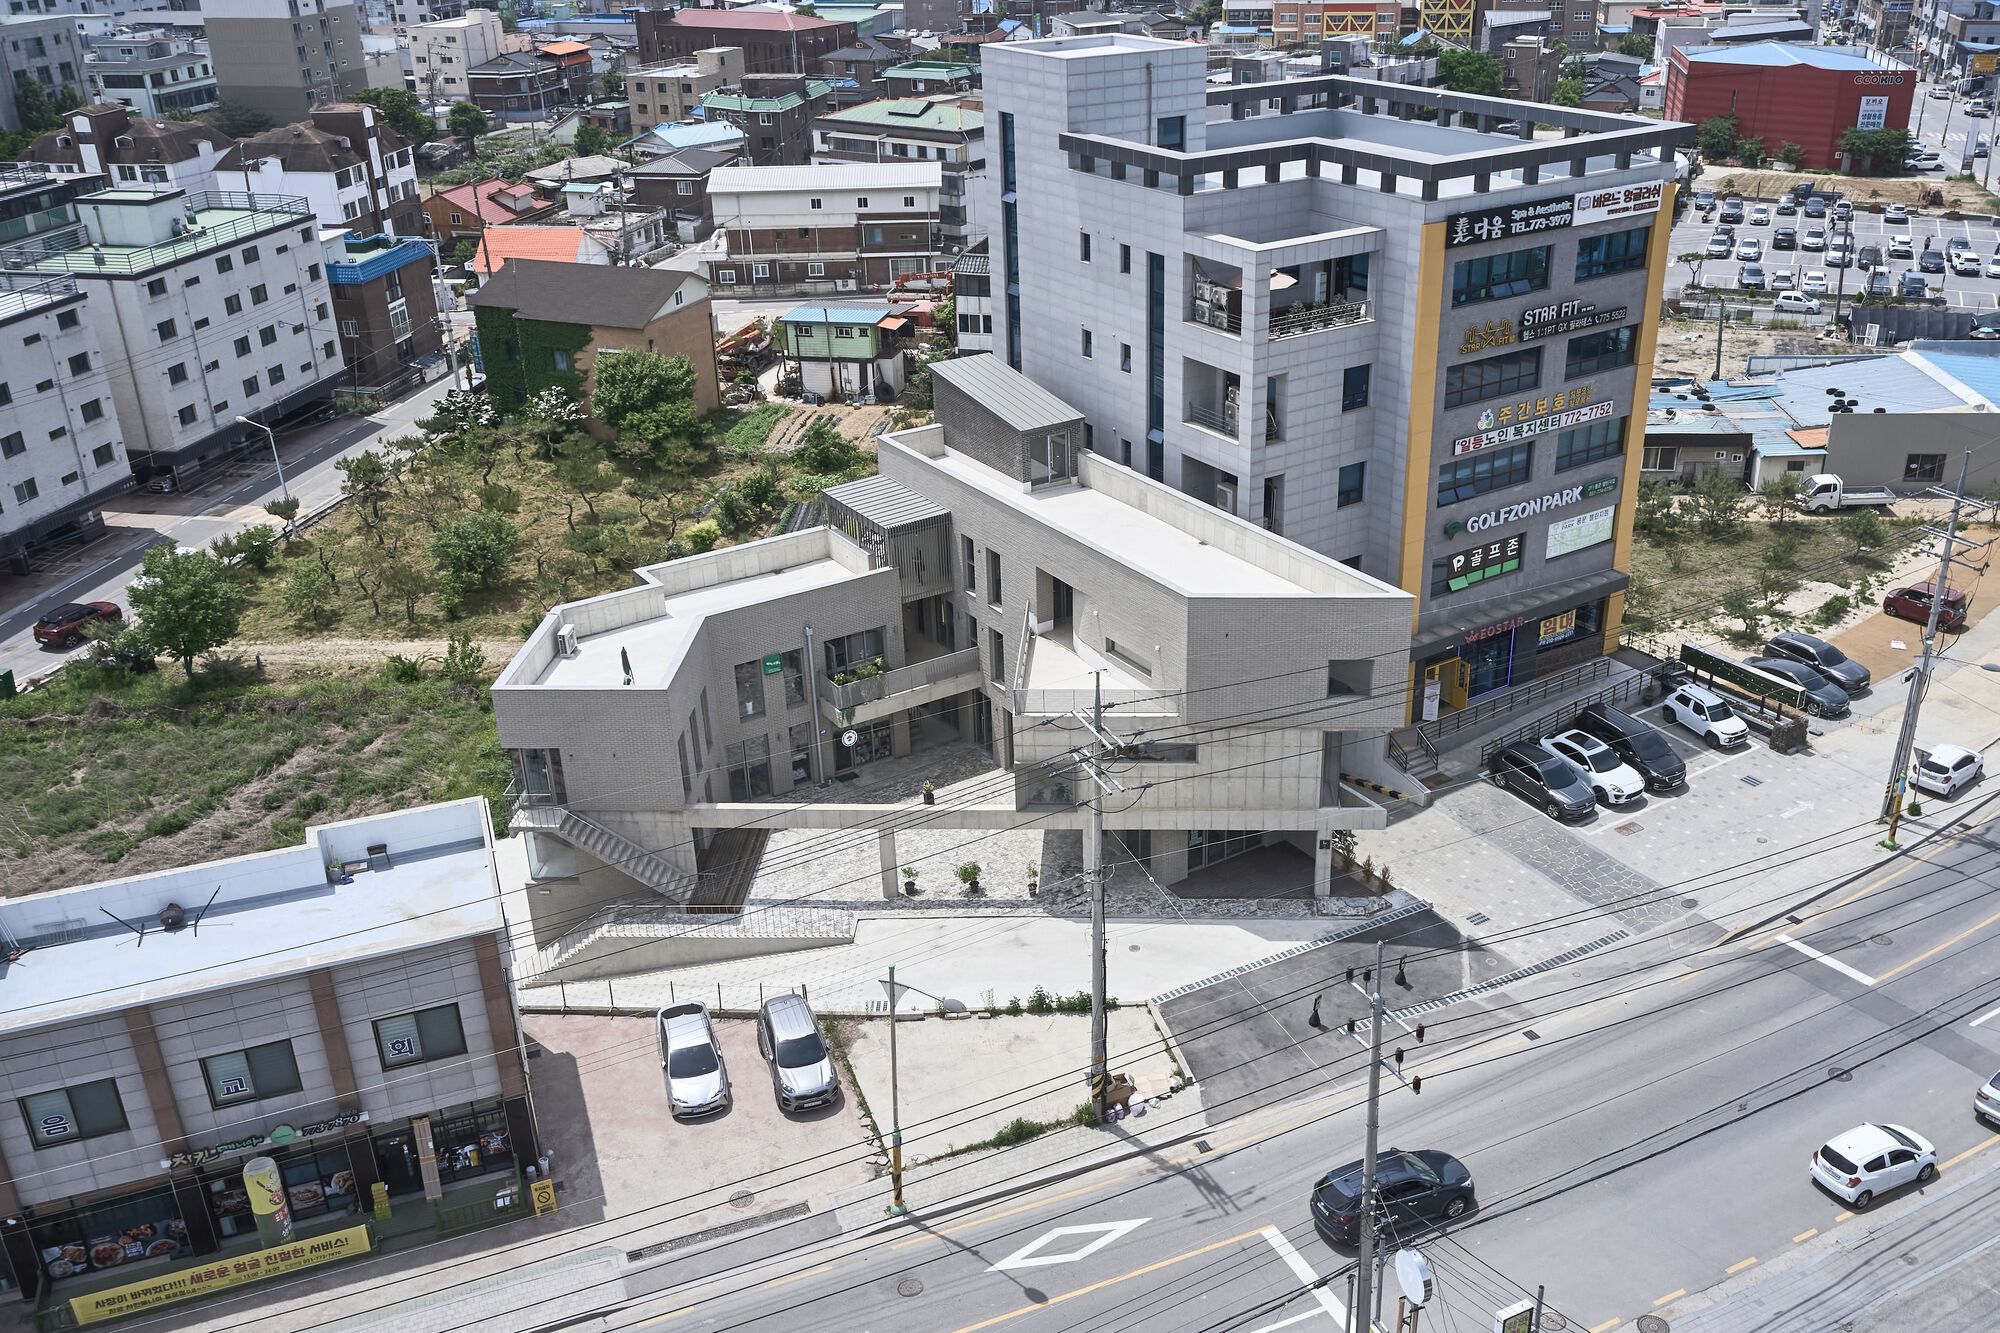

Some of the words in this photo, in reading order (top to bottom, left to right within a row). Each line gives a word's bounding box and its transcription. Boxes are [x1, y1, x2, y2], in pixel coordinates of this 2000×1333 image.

[1854, 75, 1904, 85] CCOKIO
[1511, 209, 1526, 220] Spa
[1528, 207, 1535, 217] &
[1535, 201, 1573, 215] Aesthetic
[1510, 213, 1571, 234] TEL.773-3979
[1523, 307, 1558, 326] STAR
[1561, 300, 1582, 319] FIT
[1523, 330, 1535, 340] 헬스
[1557, 322, 1568, 332] GX
[1569, 316, 1593, 330] 필라테스
[1460, 343, 1481, 354] STAR
[1498, 393, 1566, 425] 주간보호
[1512, 413, 1562, 438] 복지센터
[1564, 402, 1612, 425] 772-7752
[1471, 537, 1519, 567] 골프존
[1543, 612, 1575, 636] 임대
[40, 1113, 70, 1137] 음
[220, 1076, 249, 1097] 교
[390, 1036, 415, 1058] 회
[302, 1113, 360, 1136] 773-7870
[95, 1296, 128, 1309] 사장이
[190, 1265, 230, 1285] 새로운
[233, 1257, 262, 1274] 얼굴
[265, 1246, 306, 1265] 친절한
[309, 1237, 349, 1255] 서비스!
